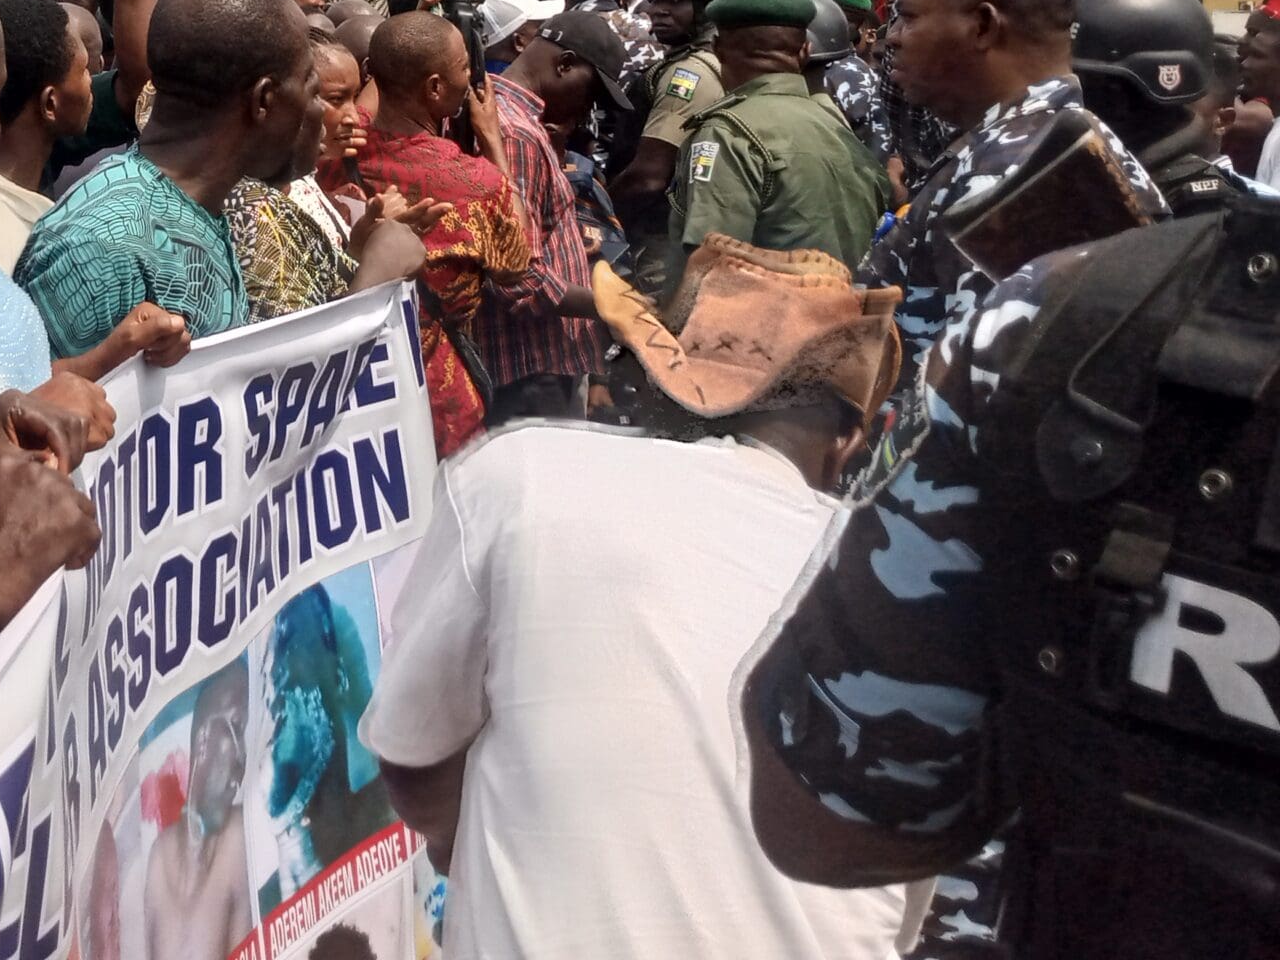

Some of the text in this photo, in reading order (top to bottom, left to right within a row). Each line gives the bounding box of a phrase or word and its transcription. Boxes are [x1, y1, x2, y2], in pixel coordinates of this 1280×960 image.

[1190, 179, 1219, 192] NPF
[87, 429, 410, 814] ASSOCIATION
[269, 832, 403, 960] ADEREMI AKEEM ADEOYE
